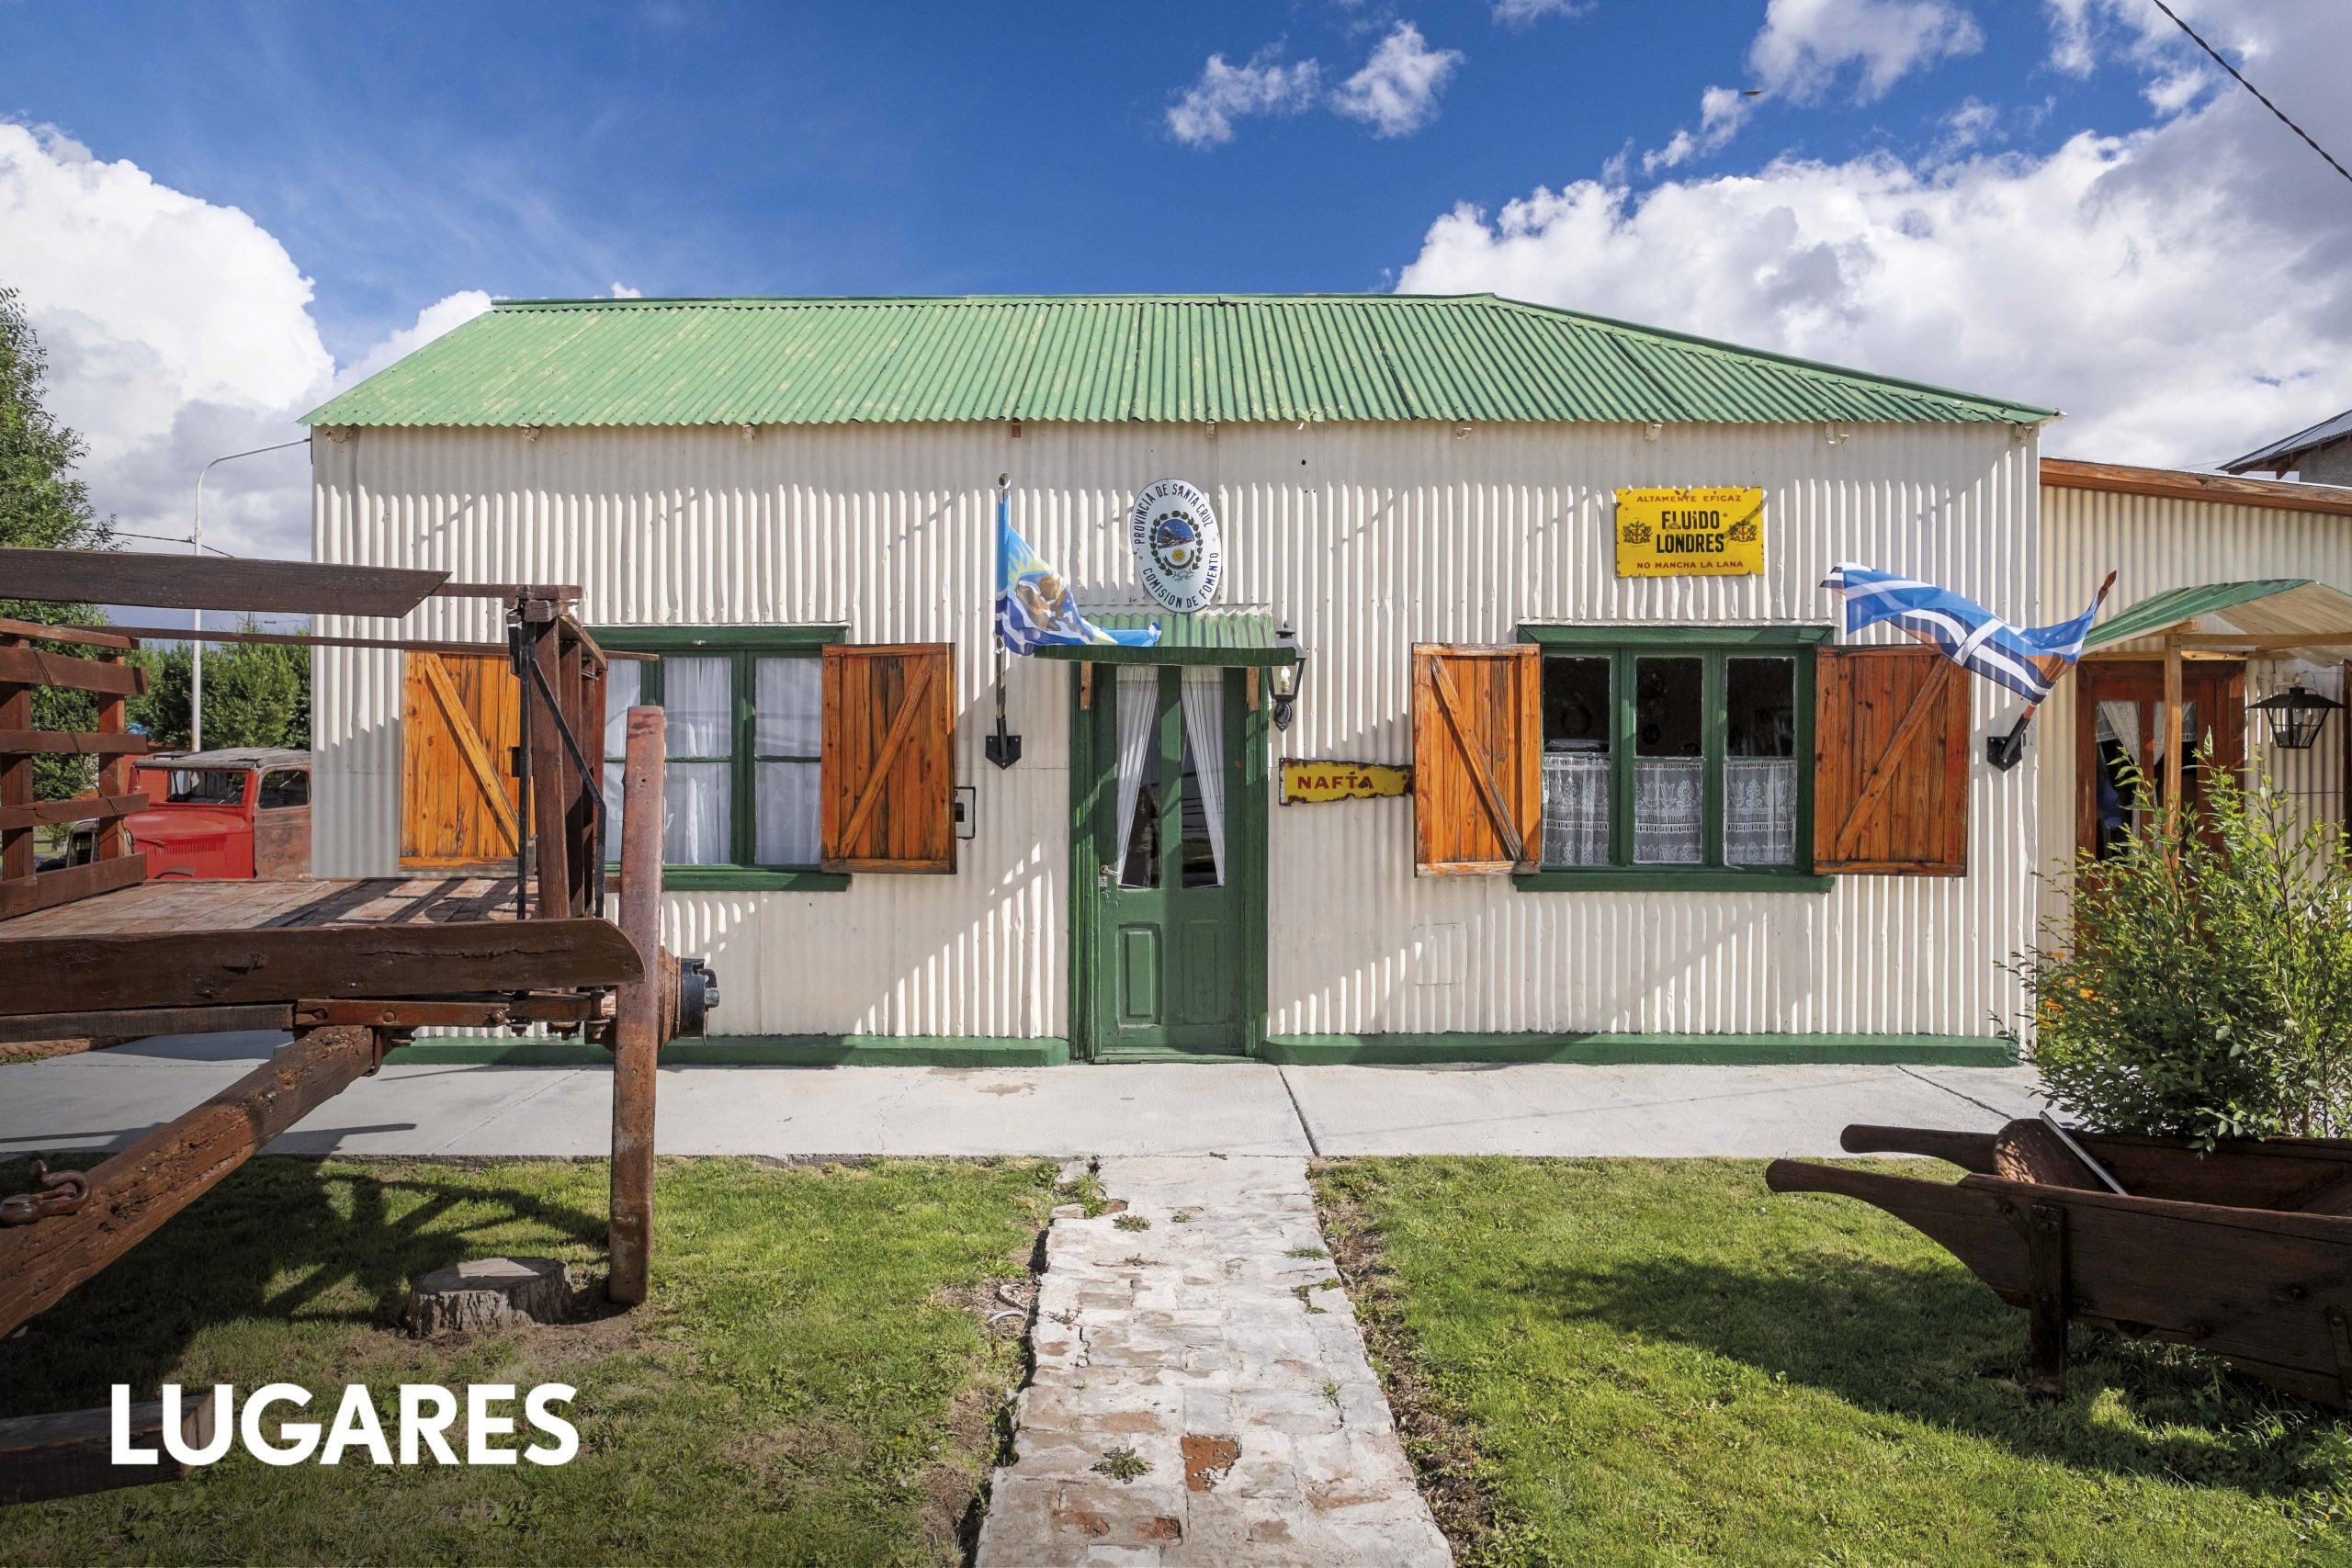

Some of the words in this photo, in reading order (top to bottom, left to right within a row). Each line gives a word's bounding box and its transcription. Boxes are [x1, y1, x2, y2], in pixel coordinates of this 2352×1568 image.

[1636, 495, 1697, 503] ALTAMENTE
[1134, 492, 1157, 545] PROVINCIA
[1155, 483, 1169, 498] DE
[1171, 483, 1200, 508] SANTA
[1195, 503, 1214, 528] CRUZ
[1656, 533, 1724, 554] LONDRES
[1655, 561, 1697, 570] MANCHA
[1716, 560, 1744, 569] LANA
[1142, 568, 1182, 609] COMISION
[1186, 595, 1199, 609] DE
[1198, 552, 1219, 600] FOMENTO
[1297, 775, 1374, 790] NAFTA
